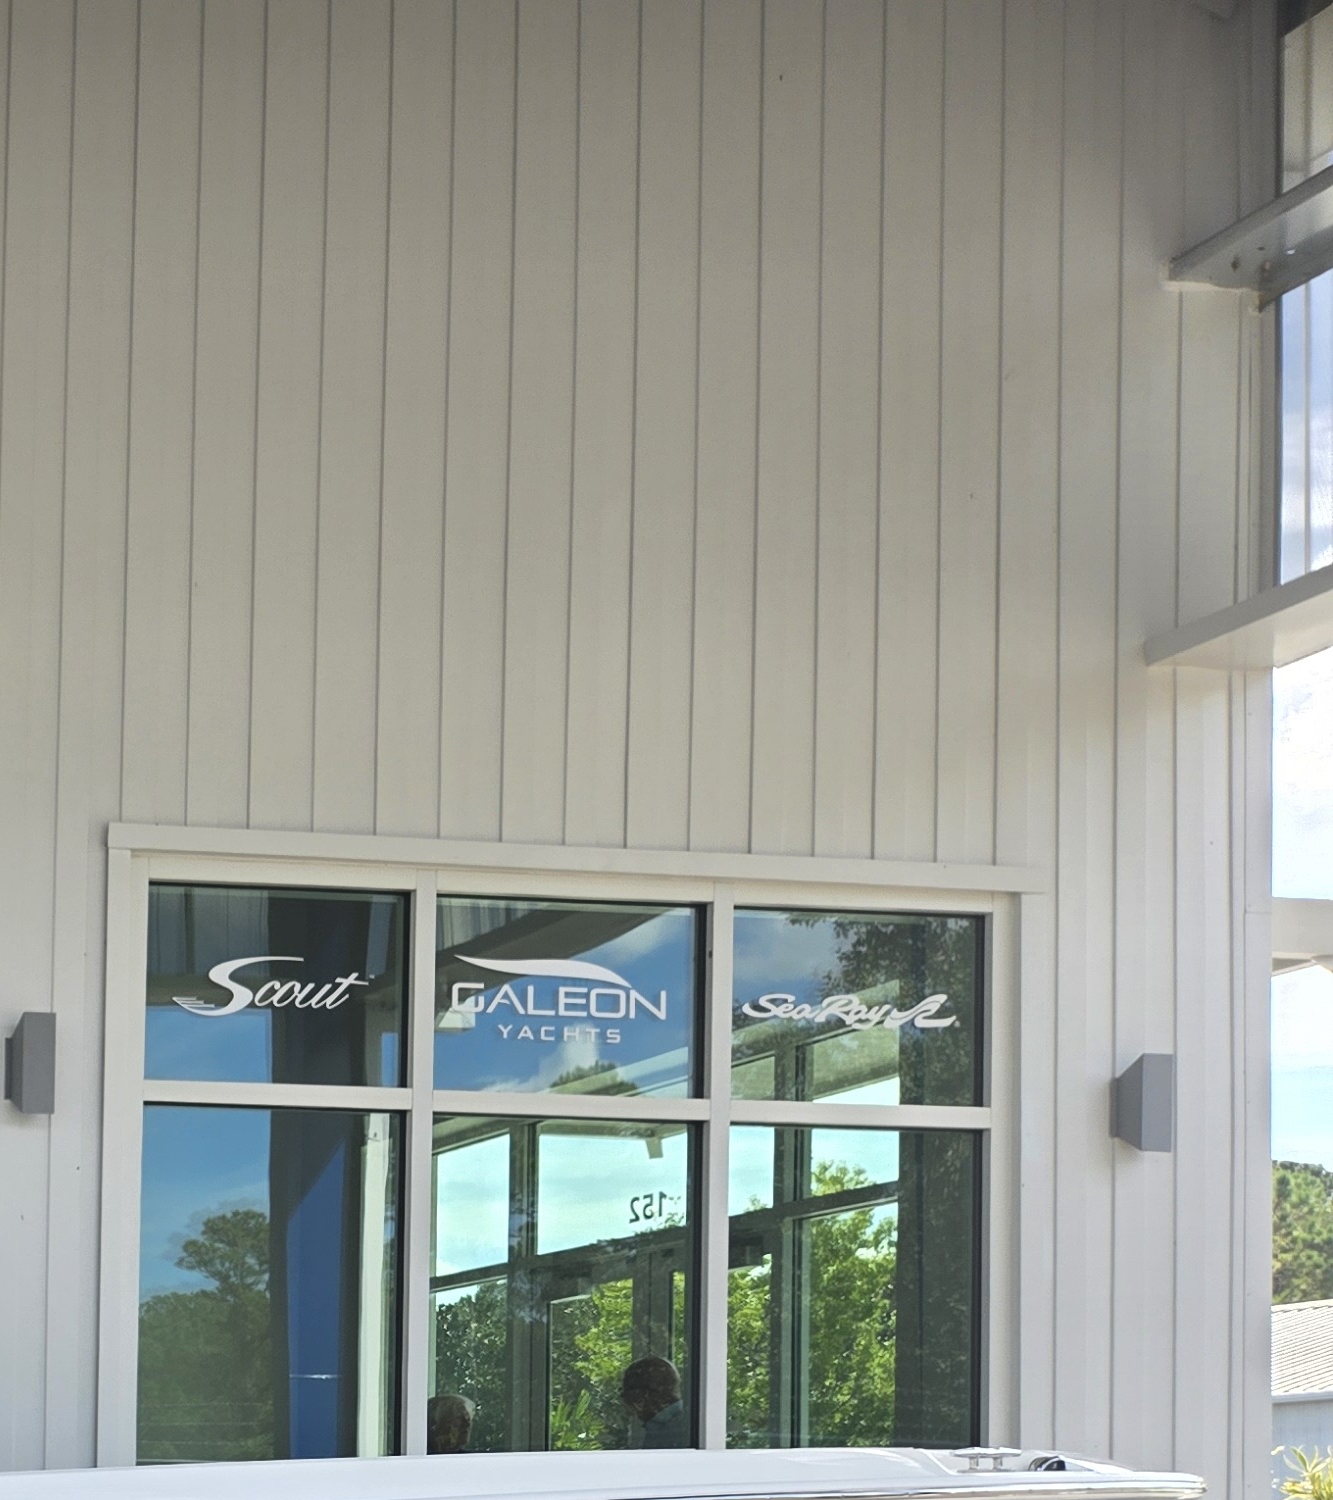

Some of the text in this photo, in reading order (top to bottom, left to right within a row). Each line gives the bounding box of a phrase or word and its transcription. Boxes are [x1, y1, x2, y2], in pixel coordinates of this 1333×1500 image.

[172, 955, 369, 1017] Scout
[451, 981, 668, 1021] GALEON
[742, 993, 891, 1030] Sea Ray
[498, 1023, 622, 1044] YACHTS
